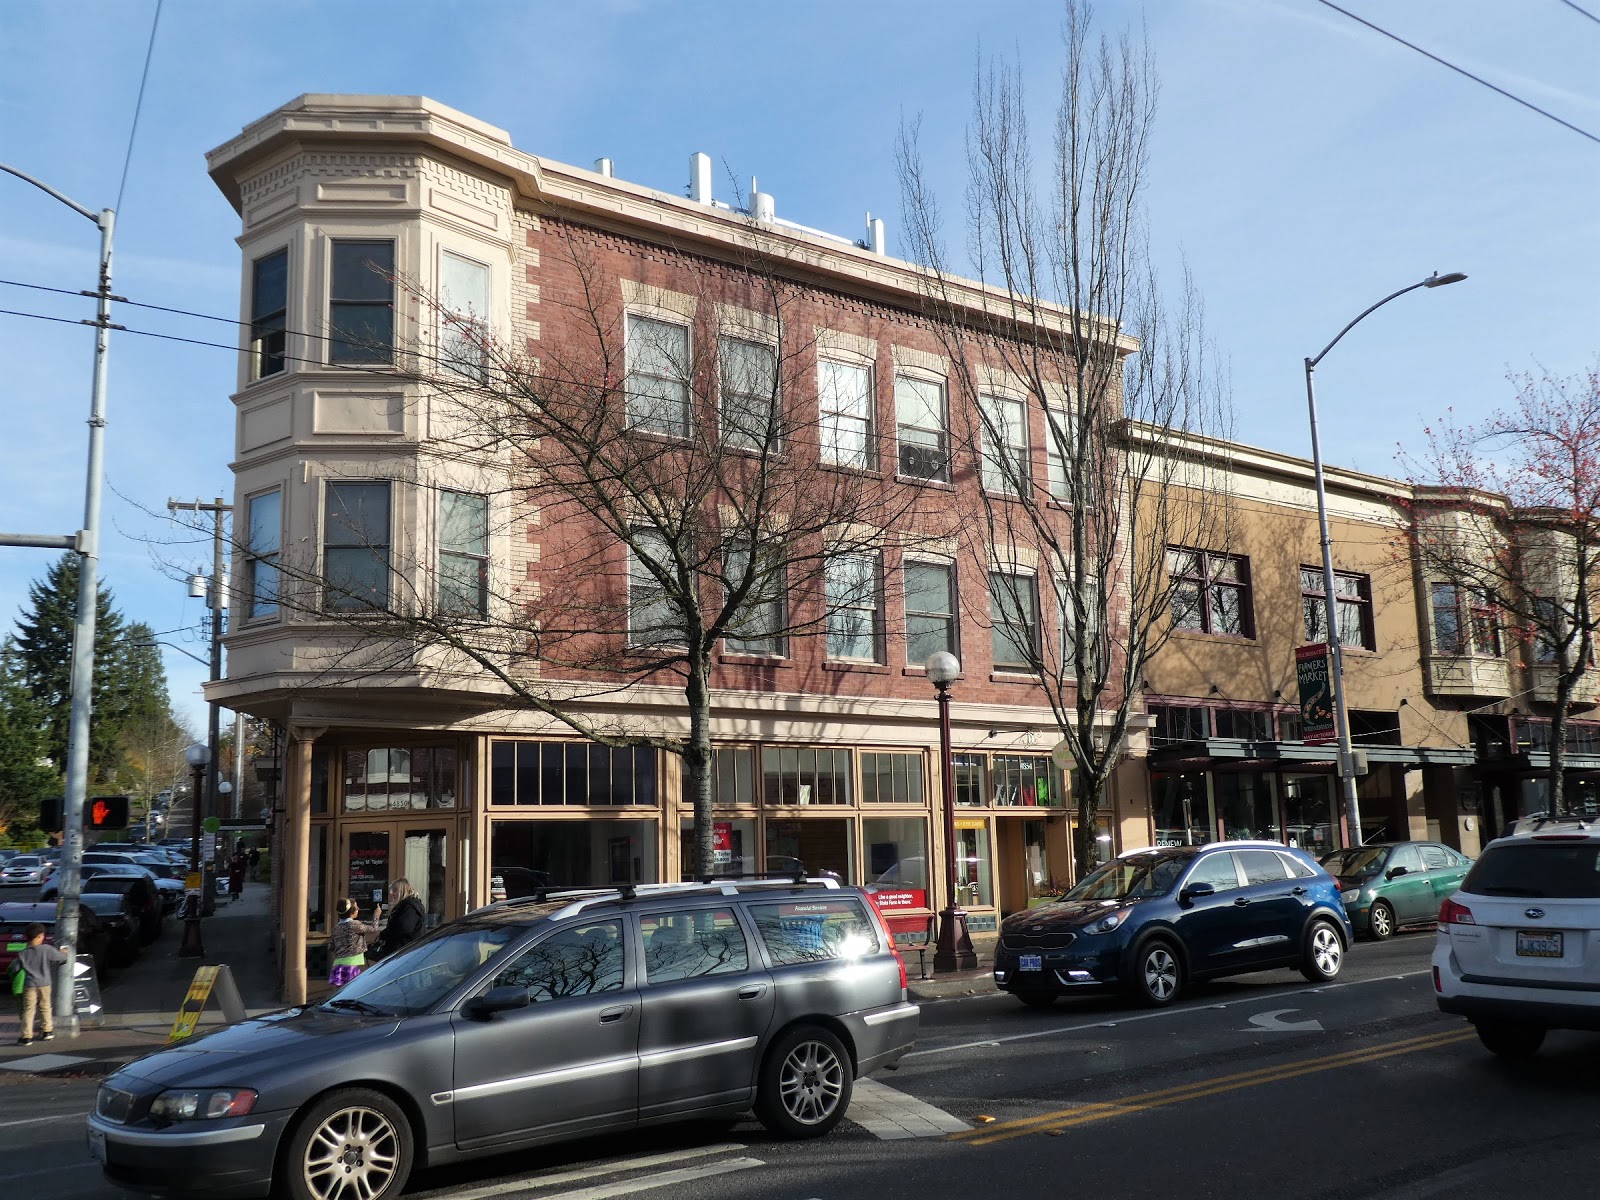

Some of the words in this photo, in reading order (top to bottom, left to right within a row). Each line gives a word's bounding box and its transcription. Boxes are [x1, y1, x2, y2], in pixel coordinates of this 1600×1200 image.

[1297, 659, 1326, 673] FARMERS
[1298, 670, 1328, 684] MARKET
[1020, 958, 1029, 967] CAR
